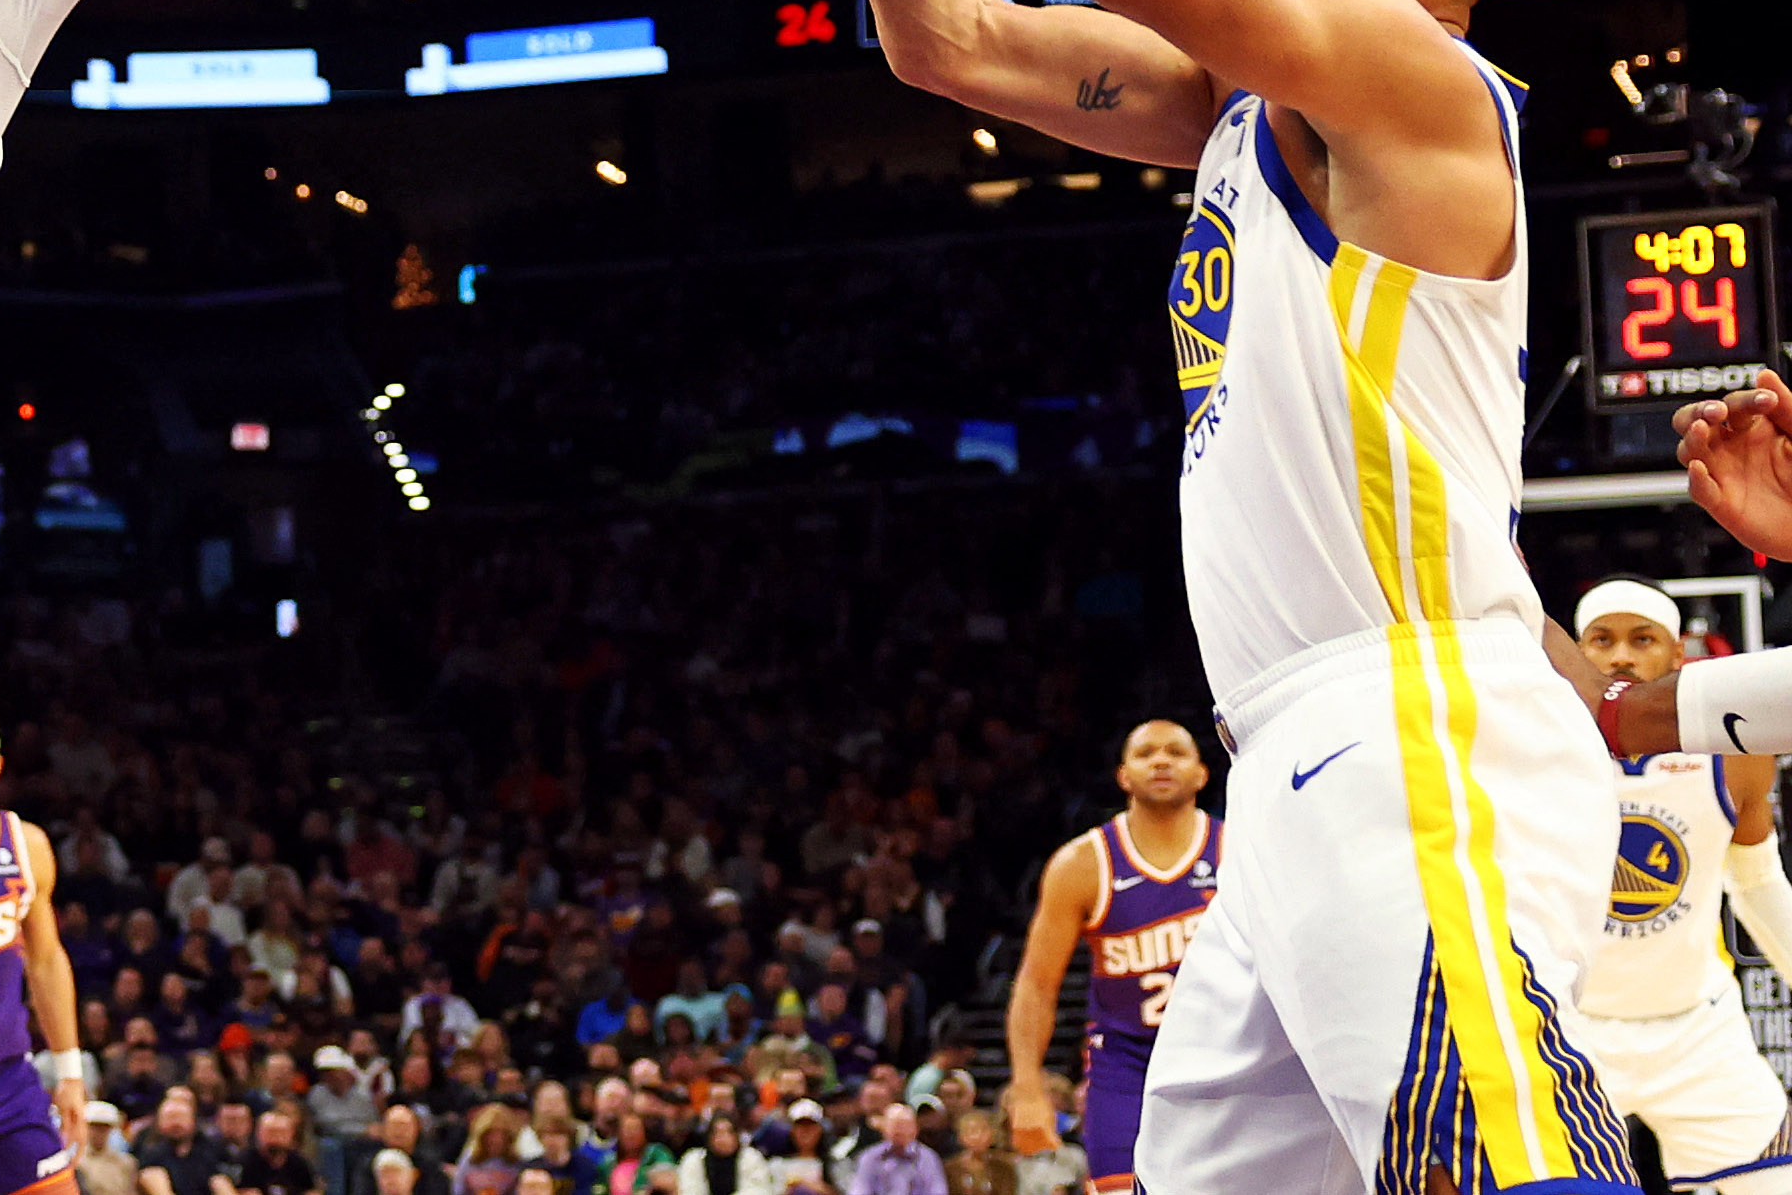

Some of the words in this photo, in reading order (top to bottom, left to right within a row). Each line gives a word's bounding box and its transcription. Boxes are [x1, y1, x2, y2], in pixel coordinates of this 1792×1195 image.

[1634, 222, 1747, 274] 4:07
[1177, 246, 1230, 317] 30
[1622, 276, 1739, 360] 24
[1646, 840, 1671, 873] 4
